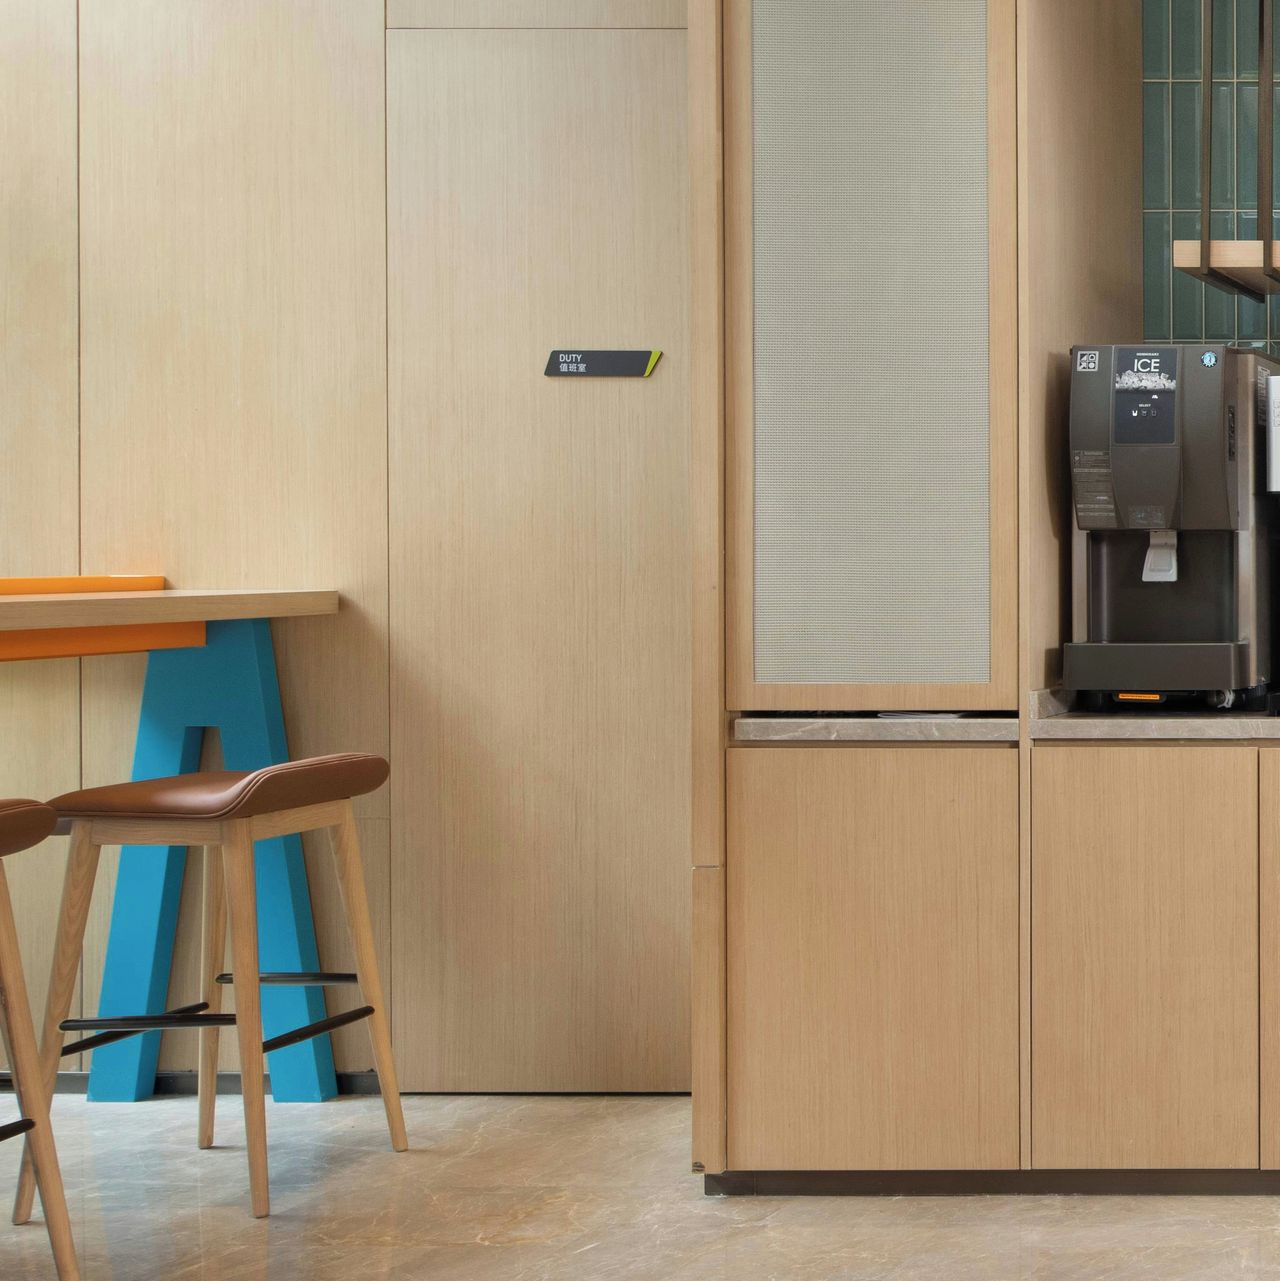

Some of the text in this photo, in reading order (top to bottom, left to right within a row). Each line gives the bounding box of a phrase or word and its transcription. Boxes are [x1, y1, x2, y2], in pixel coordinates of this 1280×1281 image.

[559, 353, 582, 362] DUTY
[559, 363, 587, 373] 值班室
[1133, 358, 1160, 372] ICE
